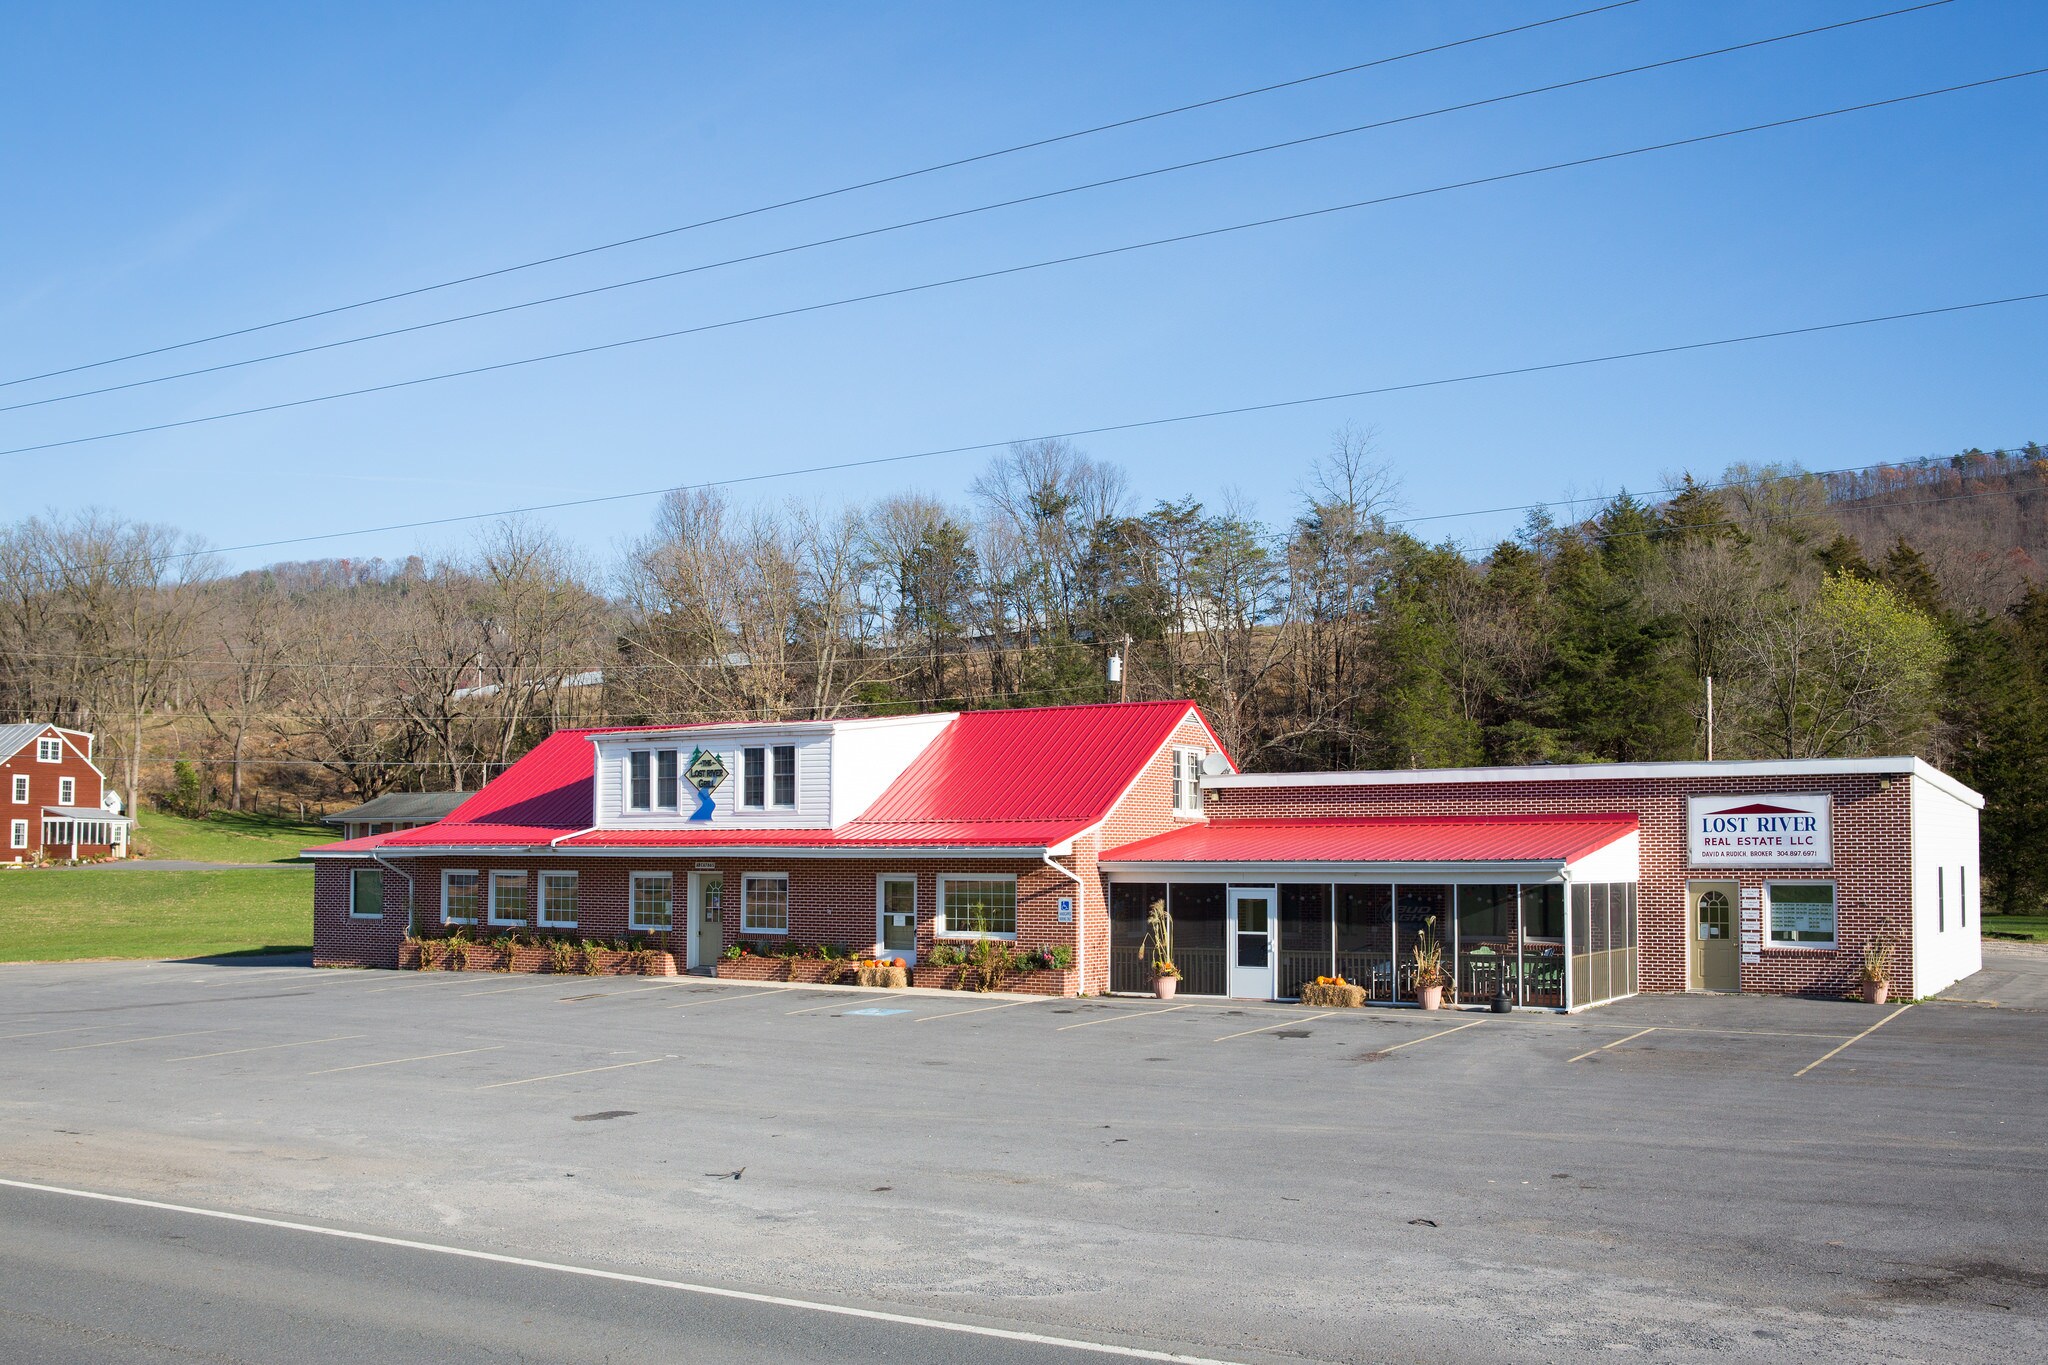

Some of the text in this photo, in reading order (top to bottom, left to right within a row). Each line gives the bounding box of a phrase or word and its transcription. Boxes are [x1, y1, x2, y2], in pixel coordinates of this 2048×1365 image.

[690, 769, 723, 777] LOST RIVER
[1702, 816, 1818, 833] LOST RIVER
[1704, 836, 1814, 846] REAL ESTATE LLC
